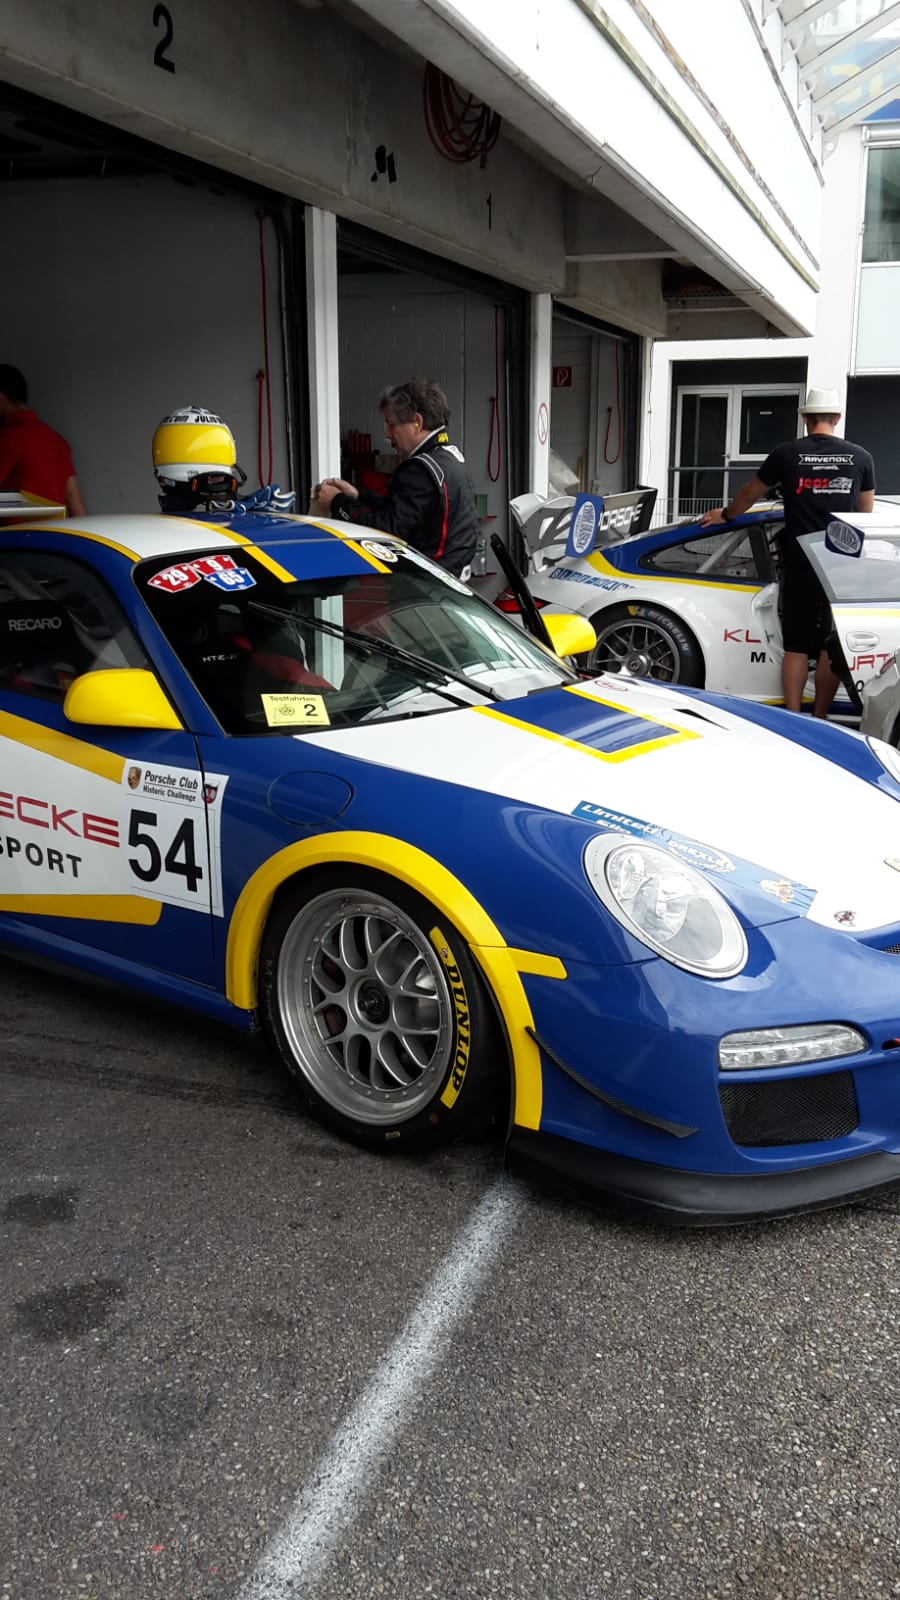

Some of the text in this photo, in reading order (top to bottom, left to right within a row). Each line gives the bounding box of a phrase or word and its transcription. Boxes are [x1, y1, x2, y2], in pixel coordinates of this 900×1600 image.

[154, 3, 175, 74] 2
[162, 570, 188, 586] 29
[8, 616, 62, 632] RECARO
[303, 704, 318, 717] 2
[144, 770, 198, 790] Porsche Club
[143, 785, 196, 802] Historic Challenge
[128, 809, 203, 893] 54
[449, 965, 470, 1091] DUNLOP
